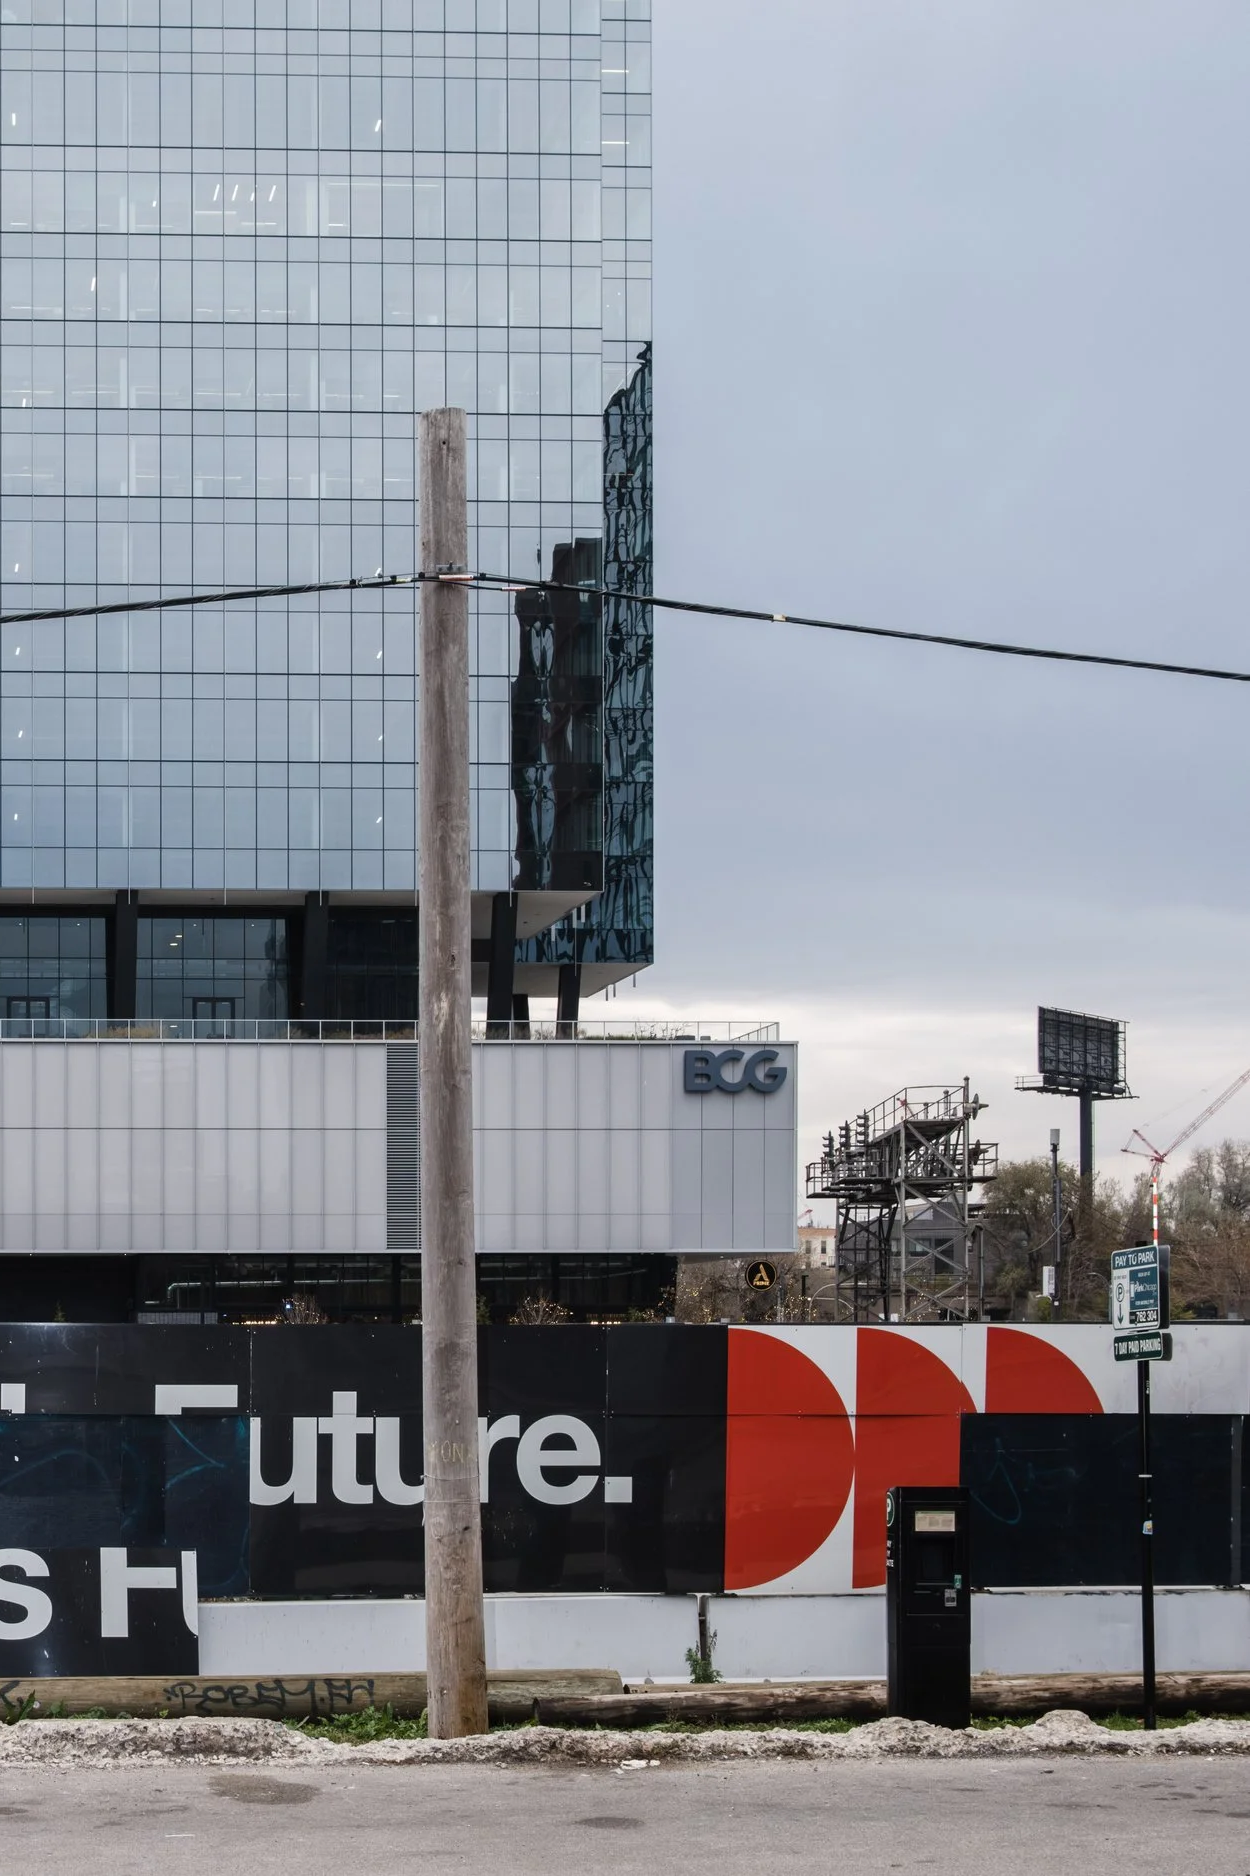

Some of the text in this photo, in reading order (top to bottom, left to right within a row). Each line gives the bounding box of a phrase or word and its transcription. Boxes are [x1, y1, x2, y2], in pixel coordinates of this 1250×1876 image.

[684, 1049, 788, 1094] BCG
[1115, 1251, 1155, 1267] PAY TO PARK
[1119, 1341, 1127, 1355] DAY
[1128, 1340, 1139, 1353] PAID
[1140, 1338, 1161, 1352] PARKING
